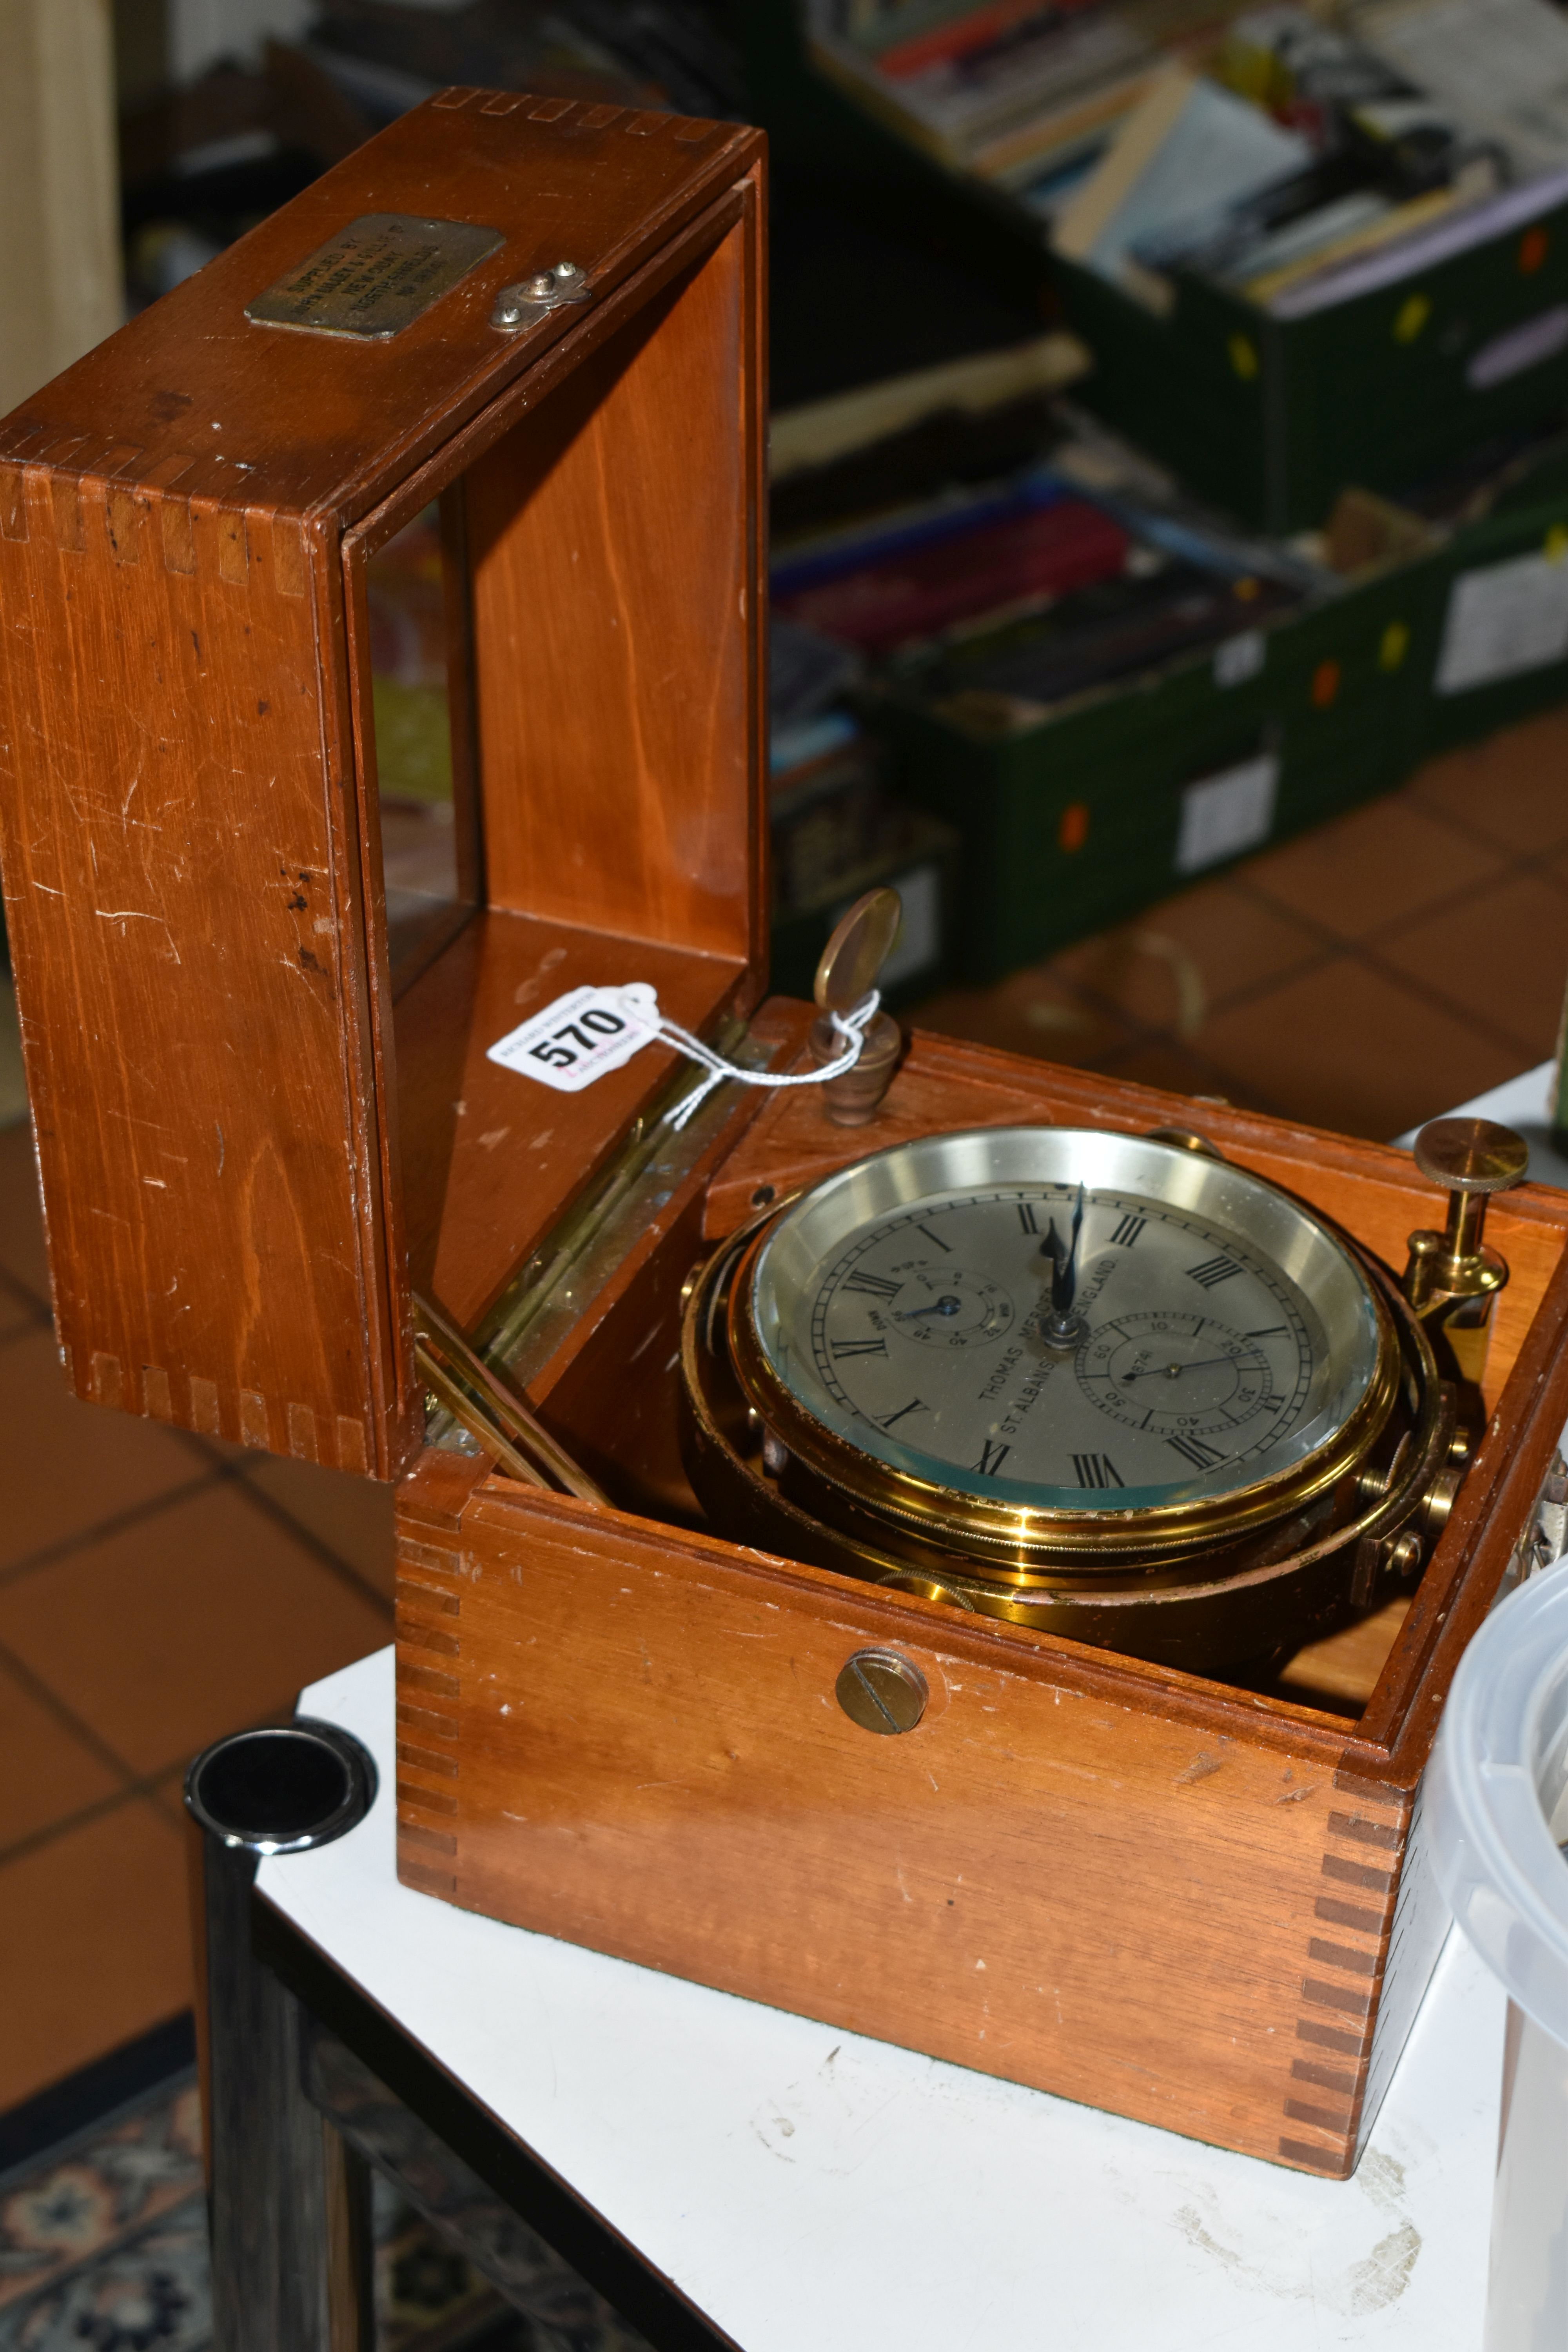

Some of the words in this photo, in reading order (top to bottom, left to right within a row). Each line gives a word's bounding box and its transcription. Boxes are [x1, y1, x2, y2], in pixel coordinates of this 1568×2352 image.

[287, 253, 345, 293] SUPPLIED
[340, 238, 362, 250] BY
[341, 274, 374, 296] NEW
[367, 251, 403, 274] QUAY
[350, 281, 393, 312] NORTH
[387, 245, 439, 280] SHIELDS
[290, 292, 325, 316] JOHN
[316, 265, 355, 294] LILLEY
[501, 1024, 544, 1057] RICHARD
[529, 1009, 625, 1068] 570
[1014, 1203, 1039, 1235] II
[1106, 1214, 1149, 1247] III
[916, 1224, 953, 1252] I
[842, 1269, 904, 1305] XII
[1186, 1256, 1245, 1290] IIII
[1220, 1340, 1241, 1354] 20
[1247, 1324, 1292, 1340] V
[832, 1338, 888, 1360] XI
[1094, 1345, 1111, 1359] 60
[1132, 1350, 1153, 1373] 8741
[978, 1347, 1023, 1400] THOMAS
[1105, 1392, 1126, 1406] 50
[1238, 1388, 1256, 1402] 30
[873, 1399, 930, 1428] X
[1001, 1415, 1022, 1434] ST.
[1178, 1417, 1200, 1426] 40
[971, 1439, 1010, 1476] IX
[1163, 1436, 1229, 1471] VII
[1068, 1453, 1125, 1488] VIII
